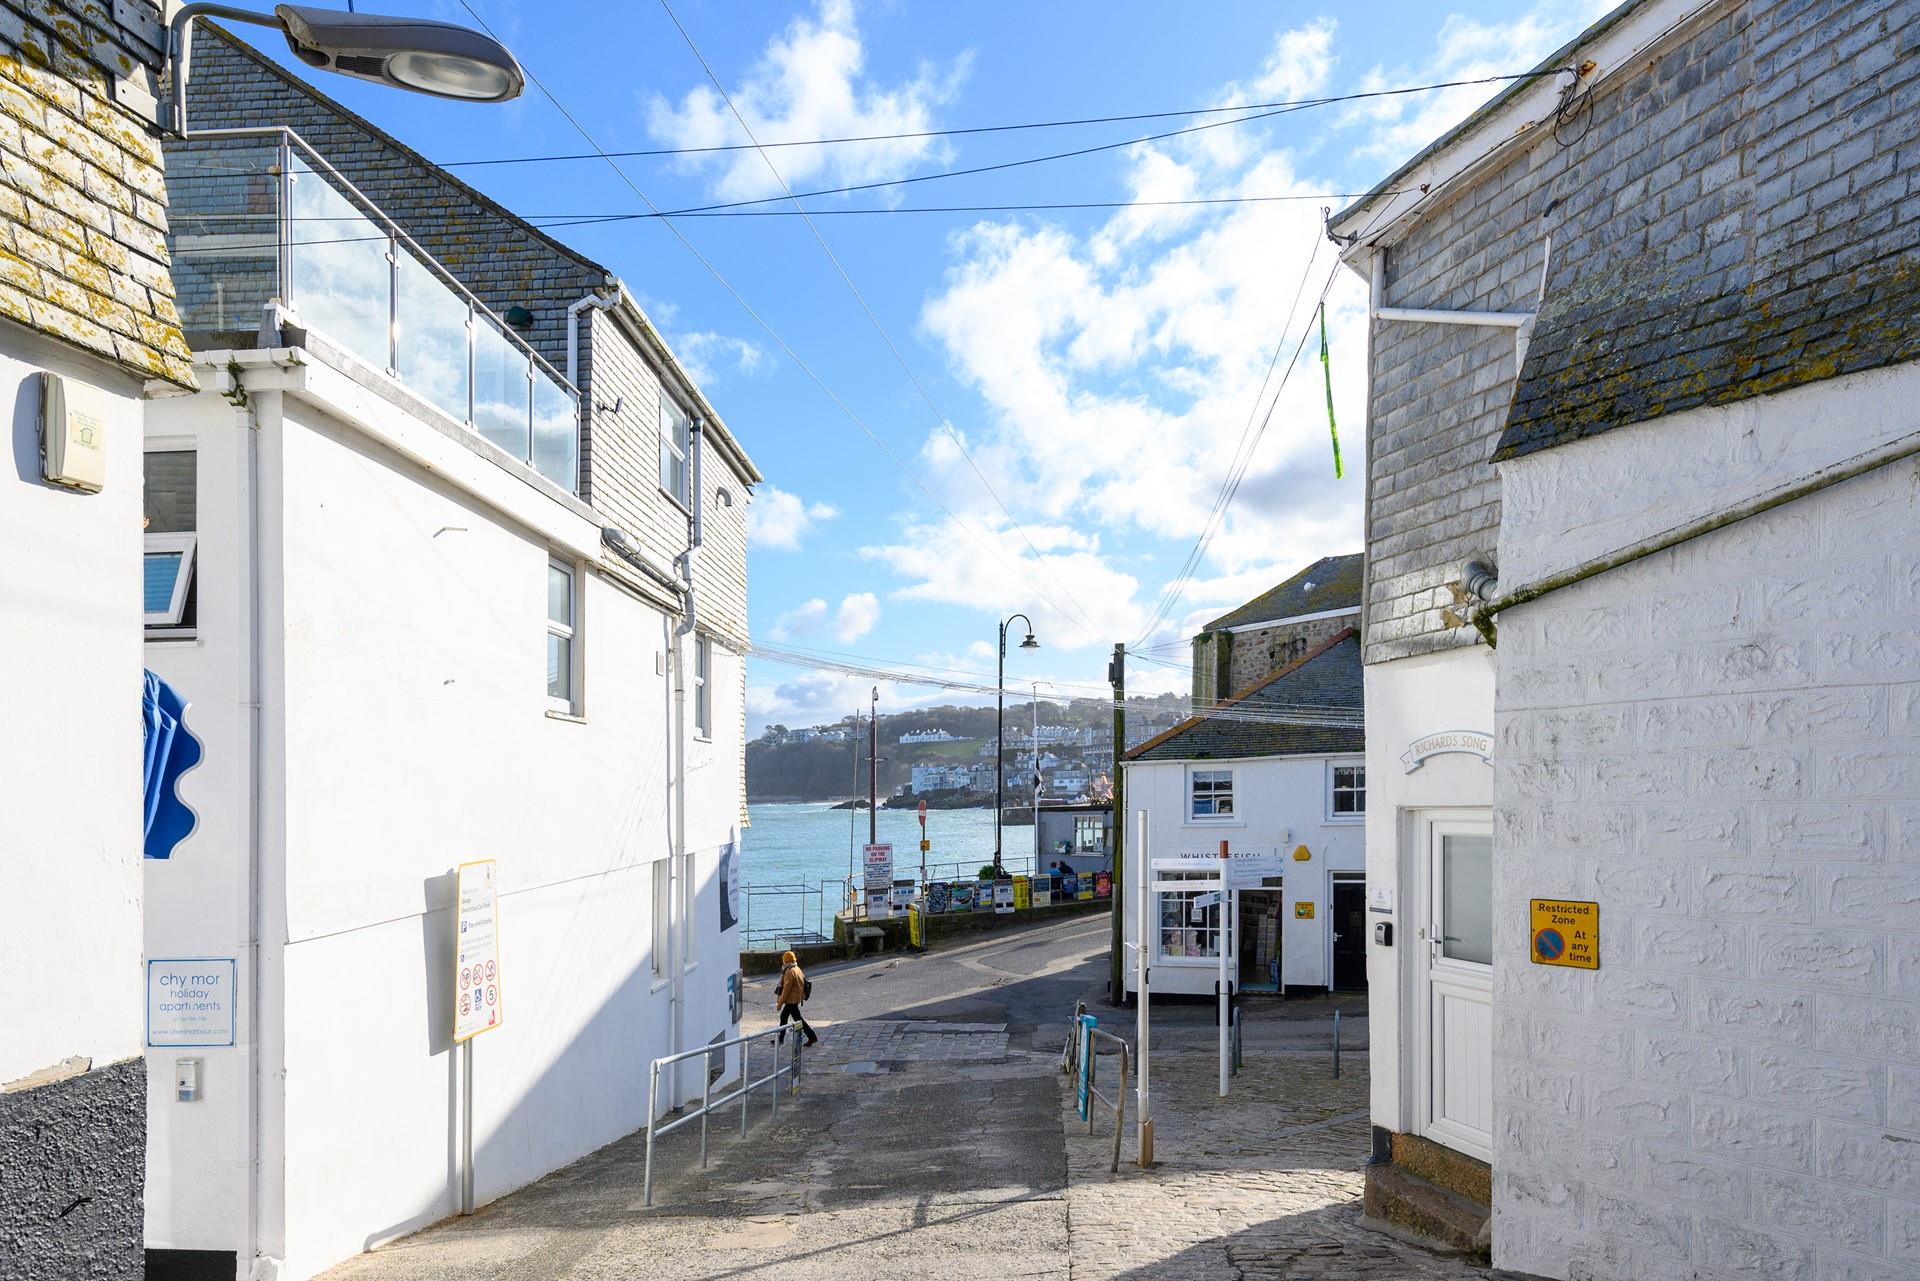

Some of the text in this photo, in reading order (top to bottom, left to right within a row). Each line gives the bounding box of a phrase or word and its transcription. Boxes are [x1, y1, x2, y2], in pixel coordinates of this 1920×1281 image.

[1415, 736, 1488, 756] RICHARD'S SONG
[1538, 903, 1589, 915] Restricted
[1552, 915, 1575, 924] Zone
[1575, 931, 1586, 939] At
[1572, 943, 1589, 952] any
[1569, 953, 1592, 962] time
[160, 973, 220, 988] chy mor
[170, 988, 209, 999] holiday
[489, 990, 494, 1000] 5
